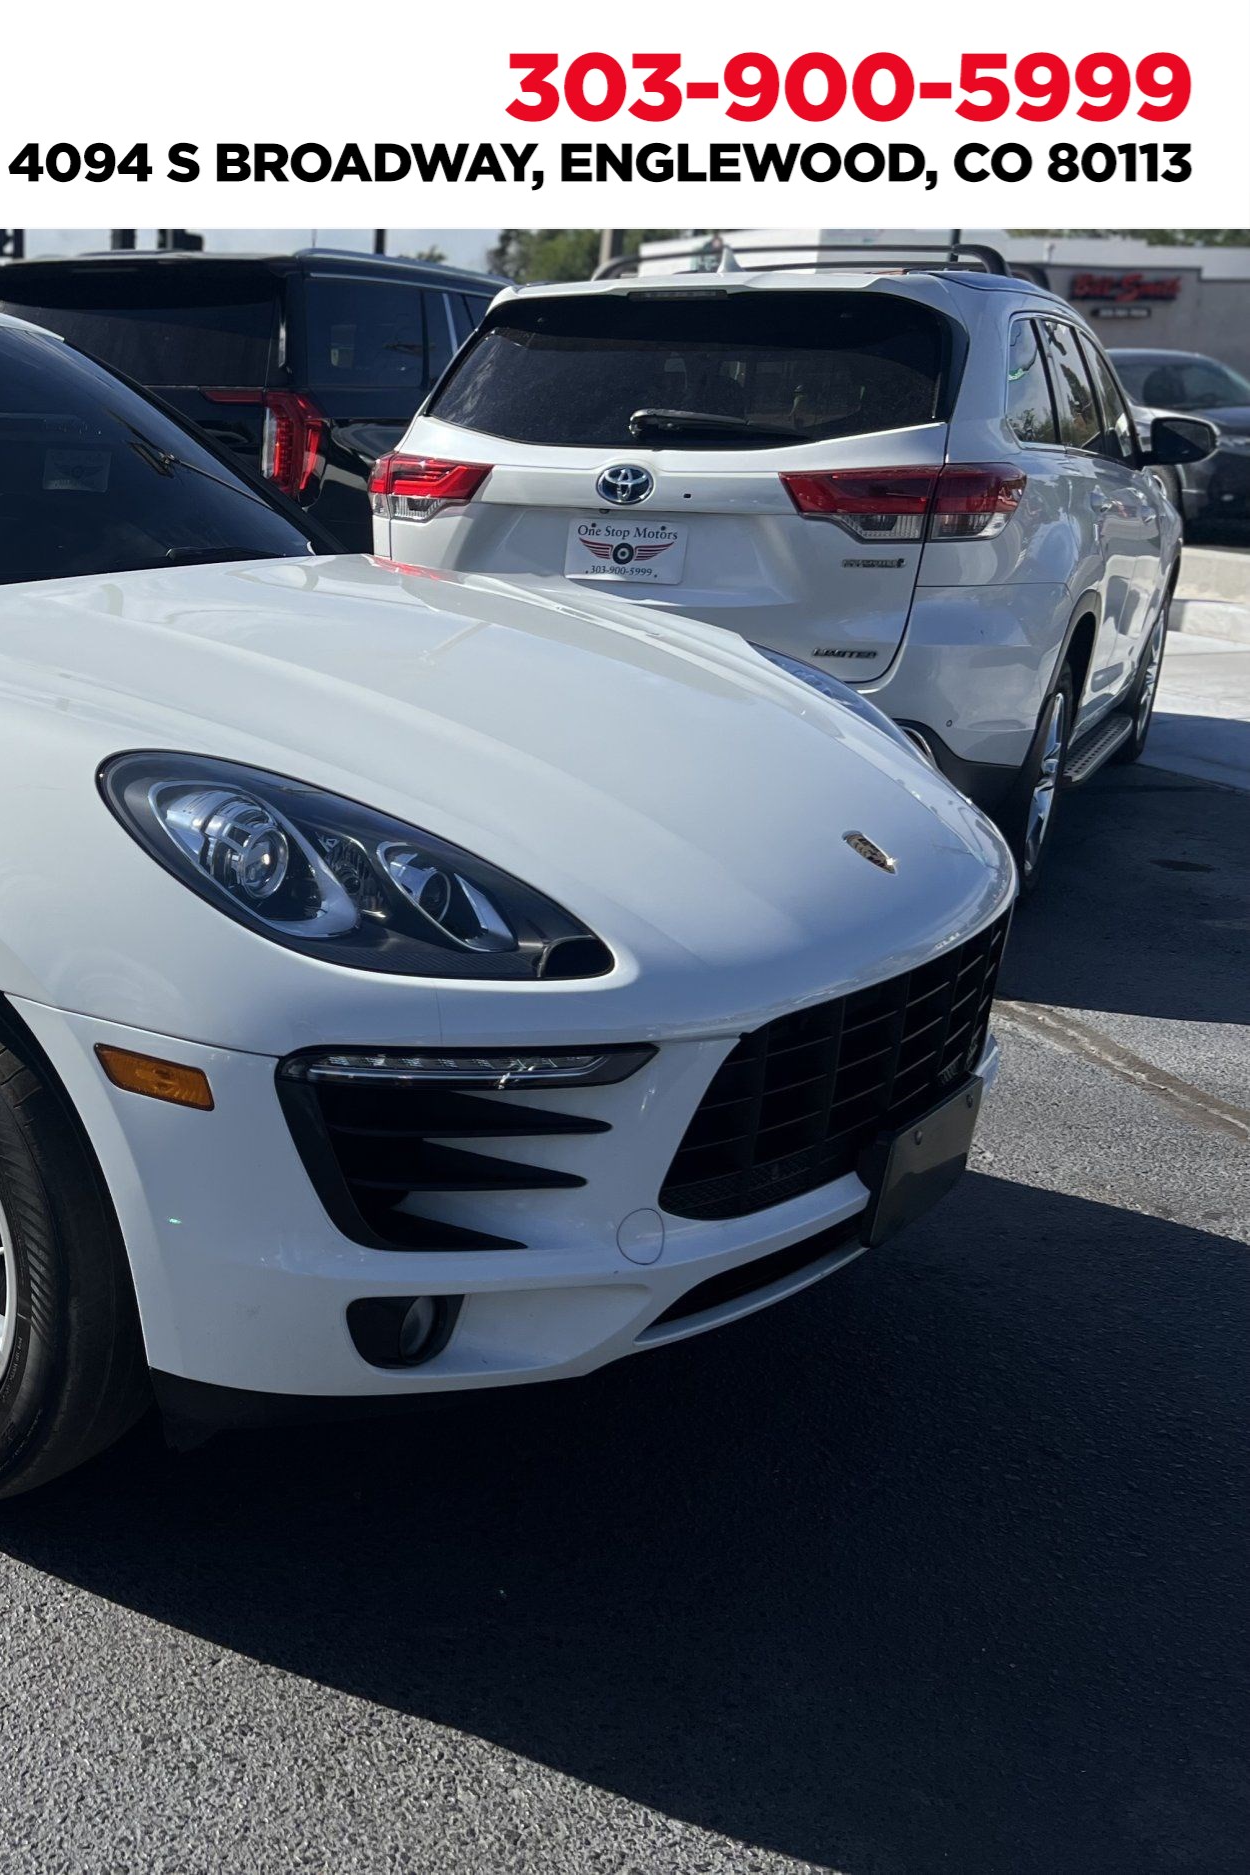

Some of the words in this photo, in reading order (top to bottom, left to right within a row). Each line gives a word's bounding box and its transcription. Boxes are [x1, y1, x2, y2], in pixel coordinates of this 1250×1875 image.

[577, 524, 602, 536] One
[604, 526, 630, 540] Stop
[633, 526, 678, 540] Motors
[590, 565, 653, 577] 303-900-5999
[813, 648, 877, 659] LIMITED
